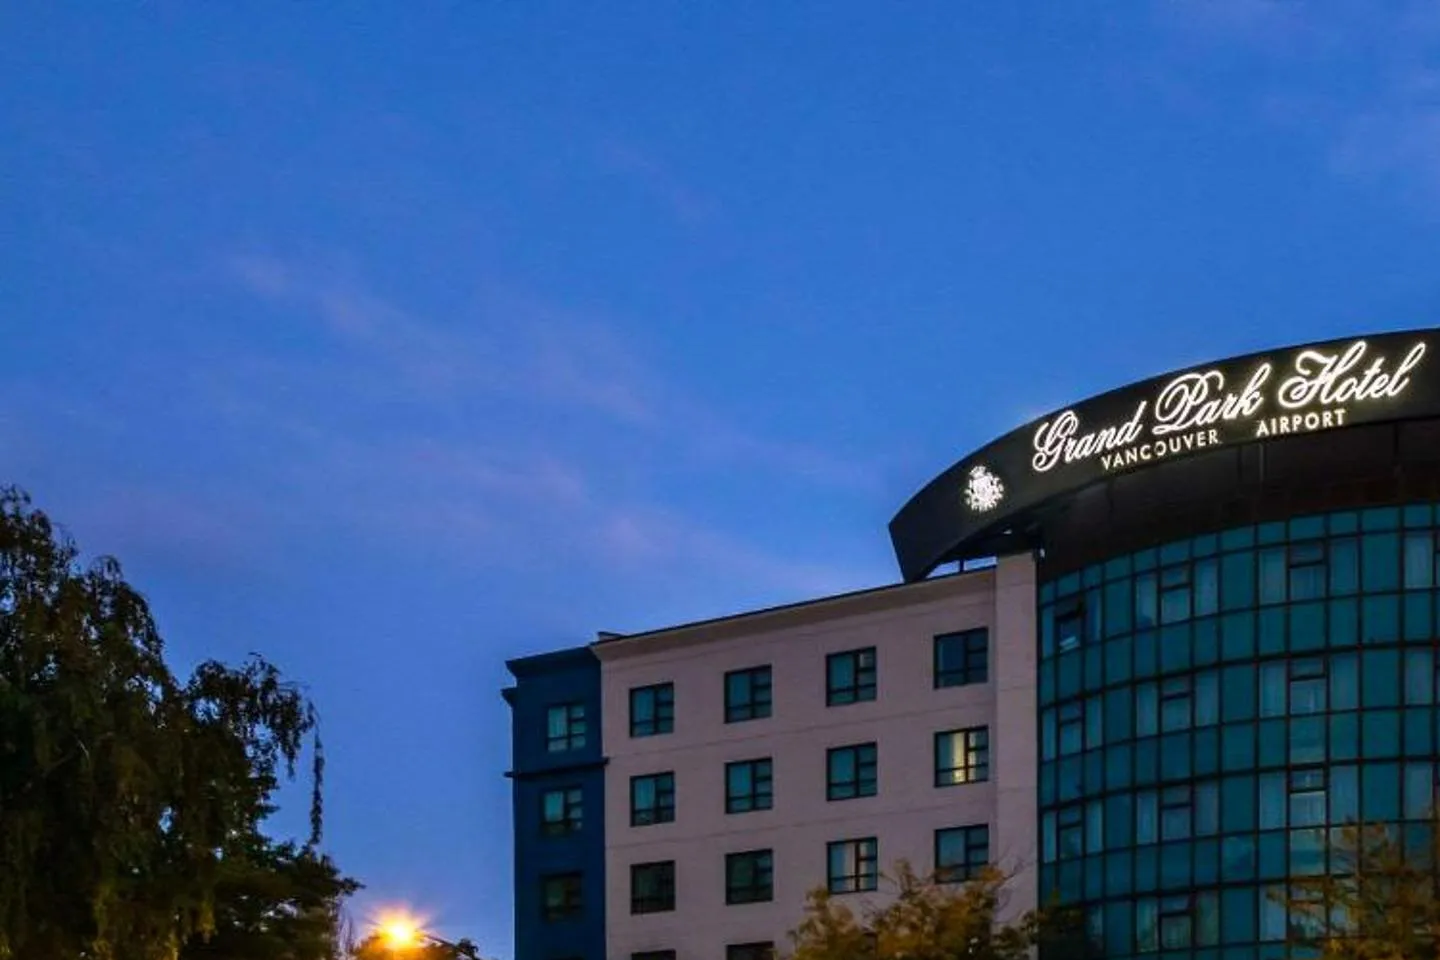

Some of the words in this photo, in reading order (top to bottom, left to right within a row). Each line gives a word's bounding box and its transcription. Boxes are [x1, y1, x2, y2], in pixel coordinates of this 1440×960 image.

[1032, 400, 1147, 472] Grand
[1152, 363, 1271, 435] Park
[1278, 340, 1426, 408] Hotel
[1101, 429, 1220, 471] VANCOUVER
[1256, 408, 1346, 438] AIRPORT
